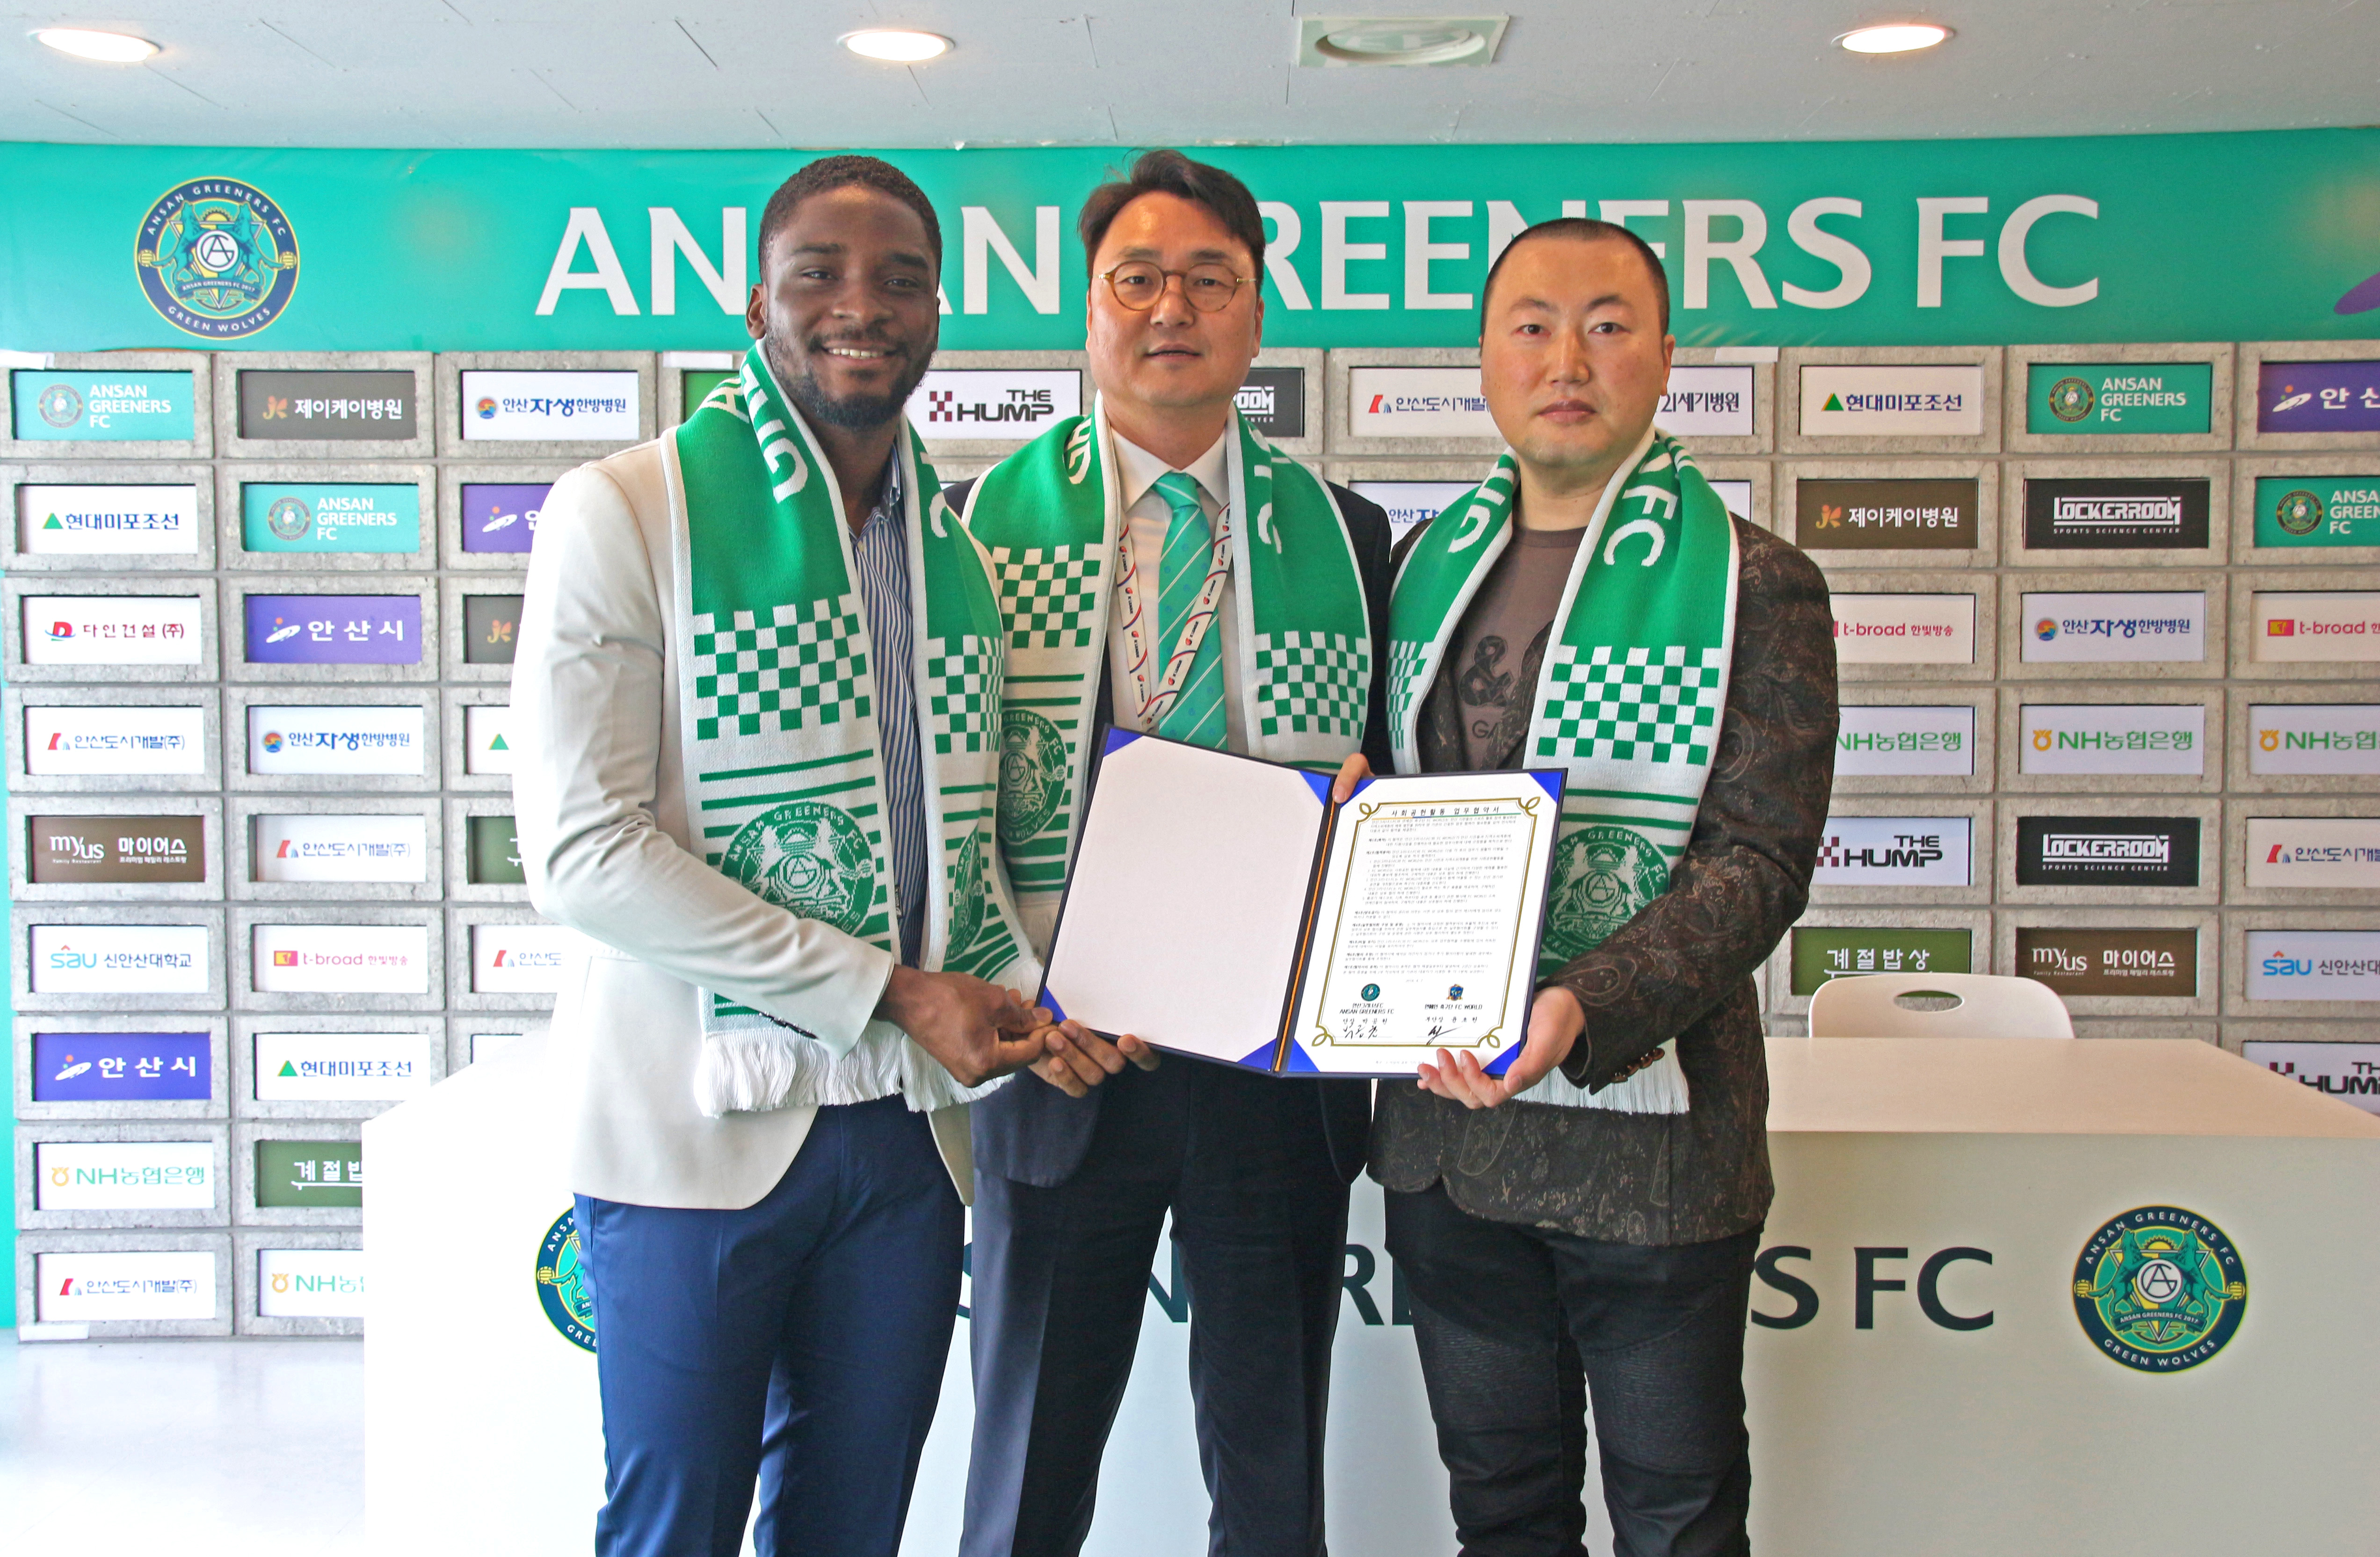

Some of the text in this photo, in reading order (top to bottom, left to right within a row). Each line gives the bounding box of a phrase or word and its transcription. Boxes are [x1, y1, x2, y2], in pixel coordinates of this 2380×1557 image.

[147, 184, 286, 236] ANSAN GREENERS FC
[535, 194, 2099, 316] ANN REERS FC
[167, 306, 271, 333] GREEN WOLVES
[89, 385, 147, 398] ANSAN
[2101, 378, 2162, 391] ANSAN
[1006, 389, 1051, 402] THE
[1396, 397, 1488, 412] 안산도시개발
[1846, 394, 1962, 412] 현대미포조선
[2101, 392, 2186, 406] GREENERS
[89, 399, 172, 414] GREENERS
[294, 399, 403, 420] 제이케이병원
[503, 398, 626, 417] 안산자생한방병원
[957, 403, 1054, 422] HUMP
[2101, 408, 2122, 422] FC
[89, 415, 111, 429] FC
[317, 497, 374, 511] ANSAN
[2330, 490, 2380, 503] ANSA
[317, 512, 397, 526] GREENERS
[1848, 507, 1958, 528] 제이케이병원
[2054, 497, 2181, 525] LOCKERROOM
[2330, 505, 2380, 519] GREEN
[65, 513, 179, 530] 현대미포조선
[1603, 484, 1678, 567] FC
[2329, 521, 2352, 534] FC
[317, 527, 338, 541] FC
[1843, 623, 1953, 636] t-broad 한빛방송
[2062, 619, 2190, 638] 안산자생한방병원
[2300, 620, 2365, 635] t-broad
[74, 735, 185, 750] 안산도시개발(주)
[289, 732, 410, 751] 안산자생한방병원
[1837, 732, 1961, 751] NH농협은행
[2058, 731, 2192, 750] NH농협은행
[2286, 731, 2380, 750] NH농협
[774, 805, 845, 826] GREENERS
[846, 829, 863, 850] FC
[118, 837, 187, 856] 마이어스
[303, 842, 411, 858] 안산도시개발(주)
[1588, 830, 1652, 858] GREENERS
[1894, 835, 1939, 848] THE
[2042, 834, 2170, 863] LOCKERROOM
[1843, 849, 1943, 867] HUMP
[104, 953, 191, 968] 신안산대학교
[303, 952, 408, 966] t-broad 한빛방송
[2103, 949, 2175, 968] 마이어스
[2318, 960, 2380, 975] 신안산대
[300, 1060, 412, 1077] 현대미포조선
[2351, 1062, 2380, 1075] TH
[2299, 1075, 2380, 1094] HUM
[76, 1166, 205, 1186] NH농협은행
[547, 1216, 574, 1252] ANSA
[2085, 1211, 2234, 1265] ANSAN GREENERS FC
[87, 1280, 197, 1294] 안산도시개발(주)
[1853, 1246, 1994, 1331] FC
[2120, 1313, 2141, 1323] ANSAN
[2184, 1314, 2199, 1324] 2017
[566, 1324, 597, 1347] GREE
[2104, 1339, 2216, 1367] GREEN WOLVES
